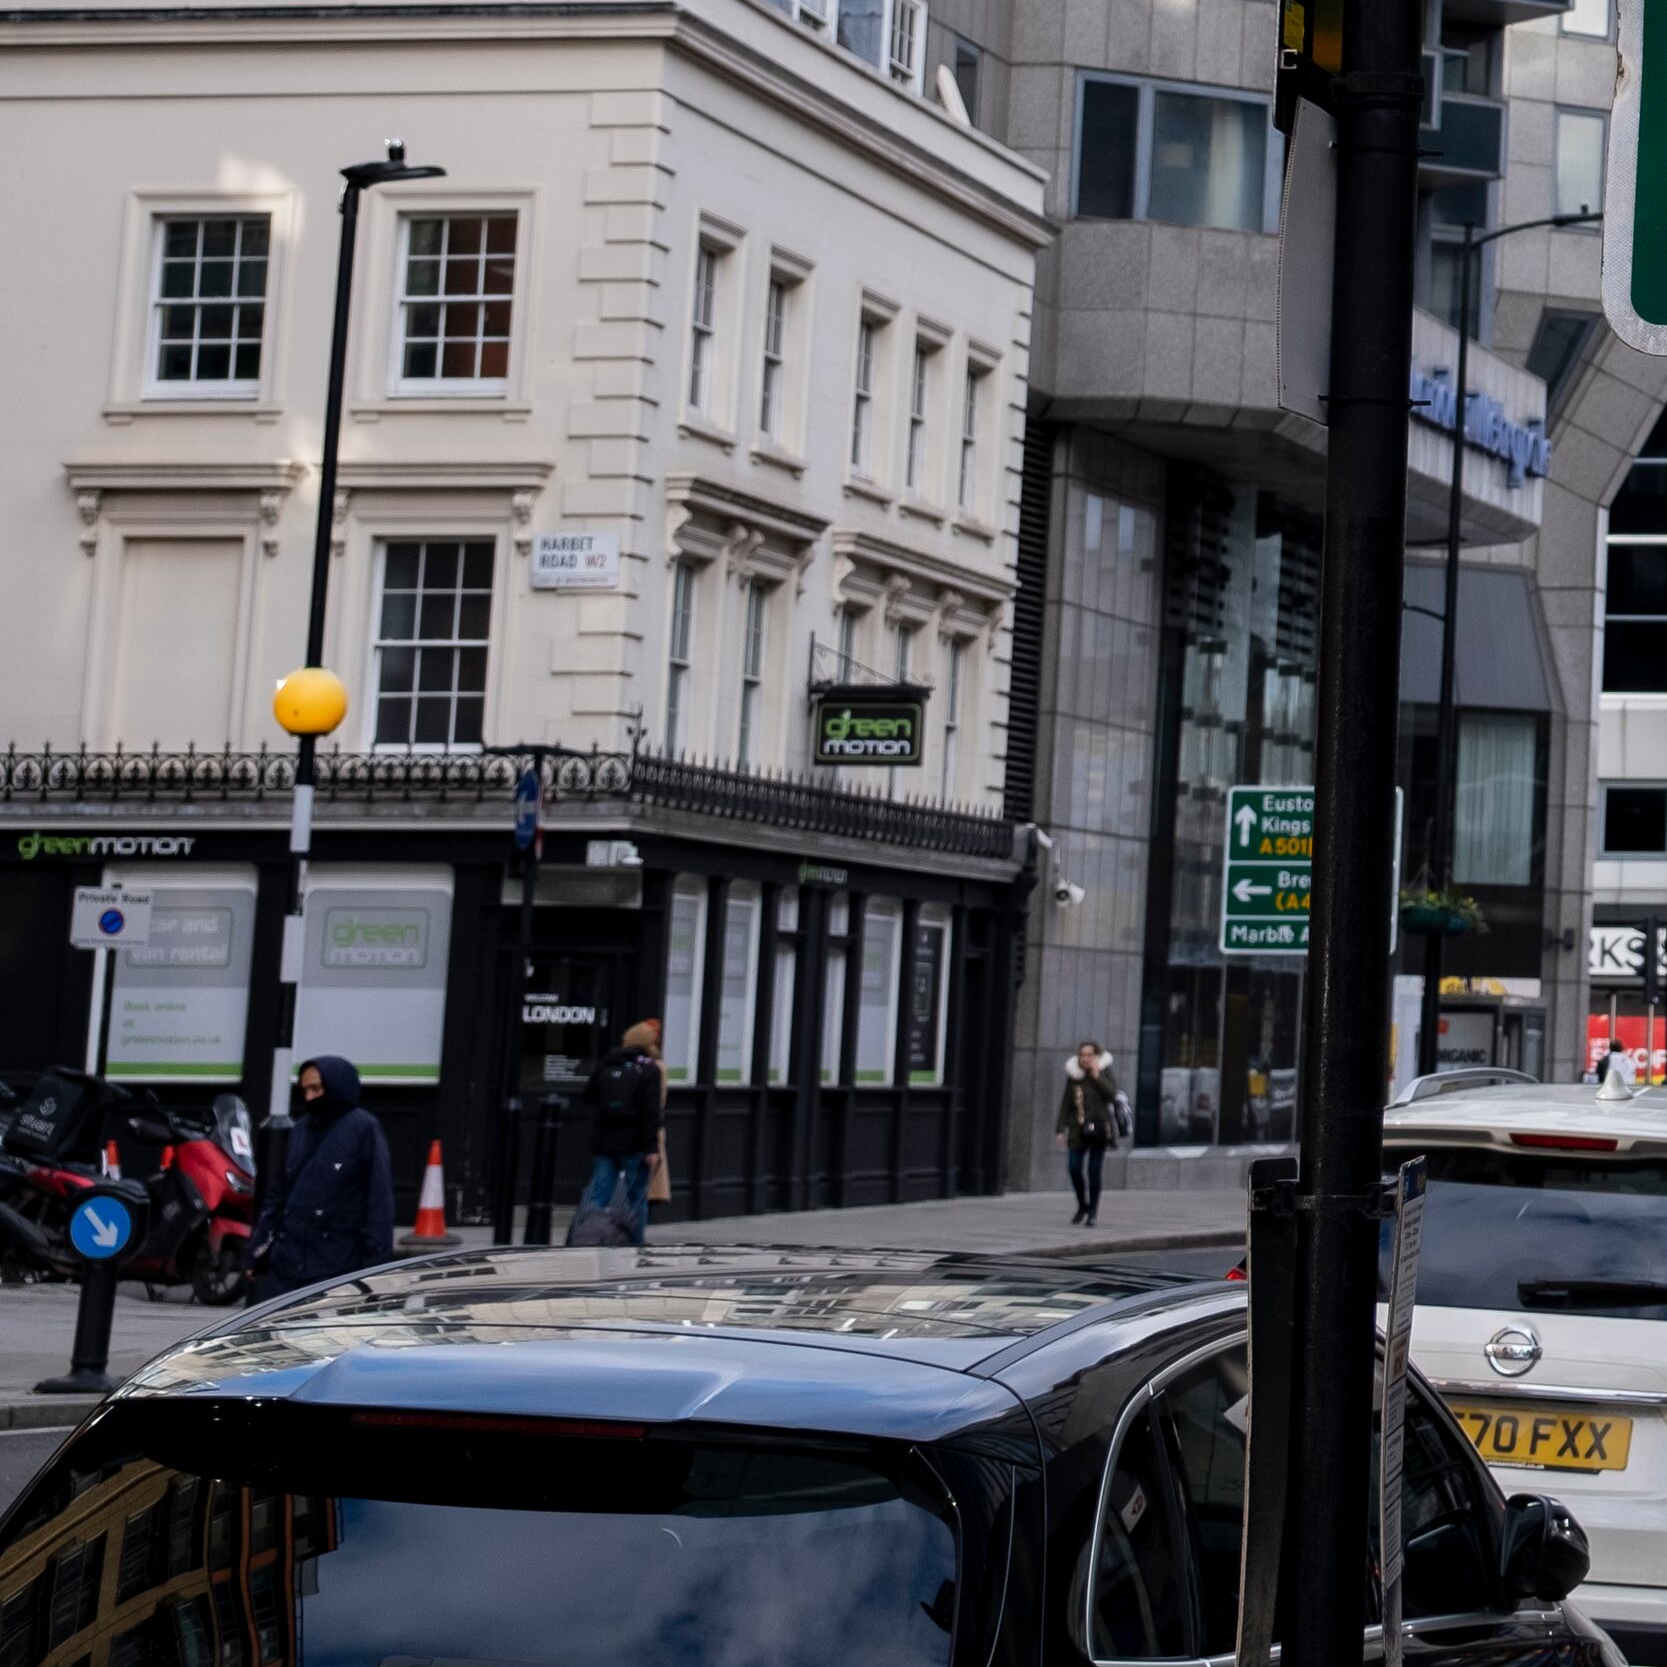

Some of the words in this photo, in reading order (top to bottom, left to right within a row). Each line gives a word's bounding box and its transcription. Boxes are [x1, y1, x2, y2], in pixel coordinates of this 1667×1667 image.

[540, 554, 578, 569] ROAD
[584, 554, 608, 568] W2
[825, 709, 912, 740] green
[1262, 795, 1314, 813] Eusto
[1261, 817, 1311, 836] Kings
[1277, 871, 1312, 888] Bre
[1275, 892, 1310, 911] (A4
[332, 917, 420, 949] green
[1230, 925, 1295, 944] Marble
[522, 1005, 595, 1024] LONDON
[1457, 1412, 1520, 1454] 70
[1529, 1418, 1612, 1461] FXX
